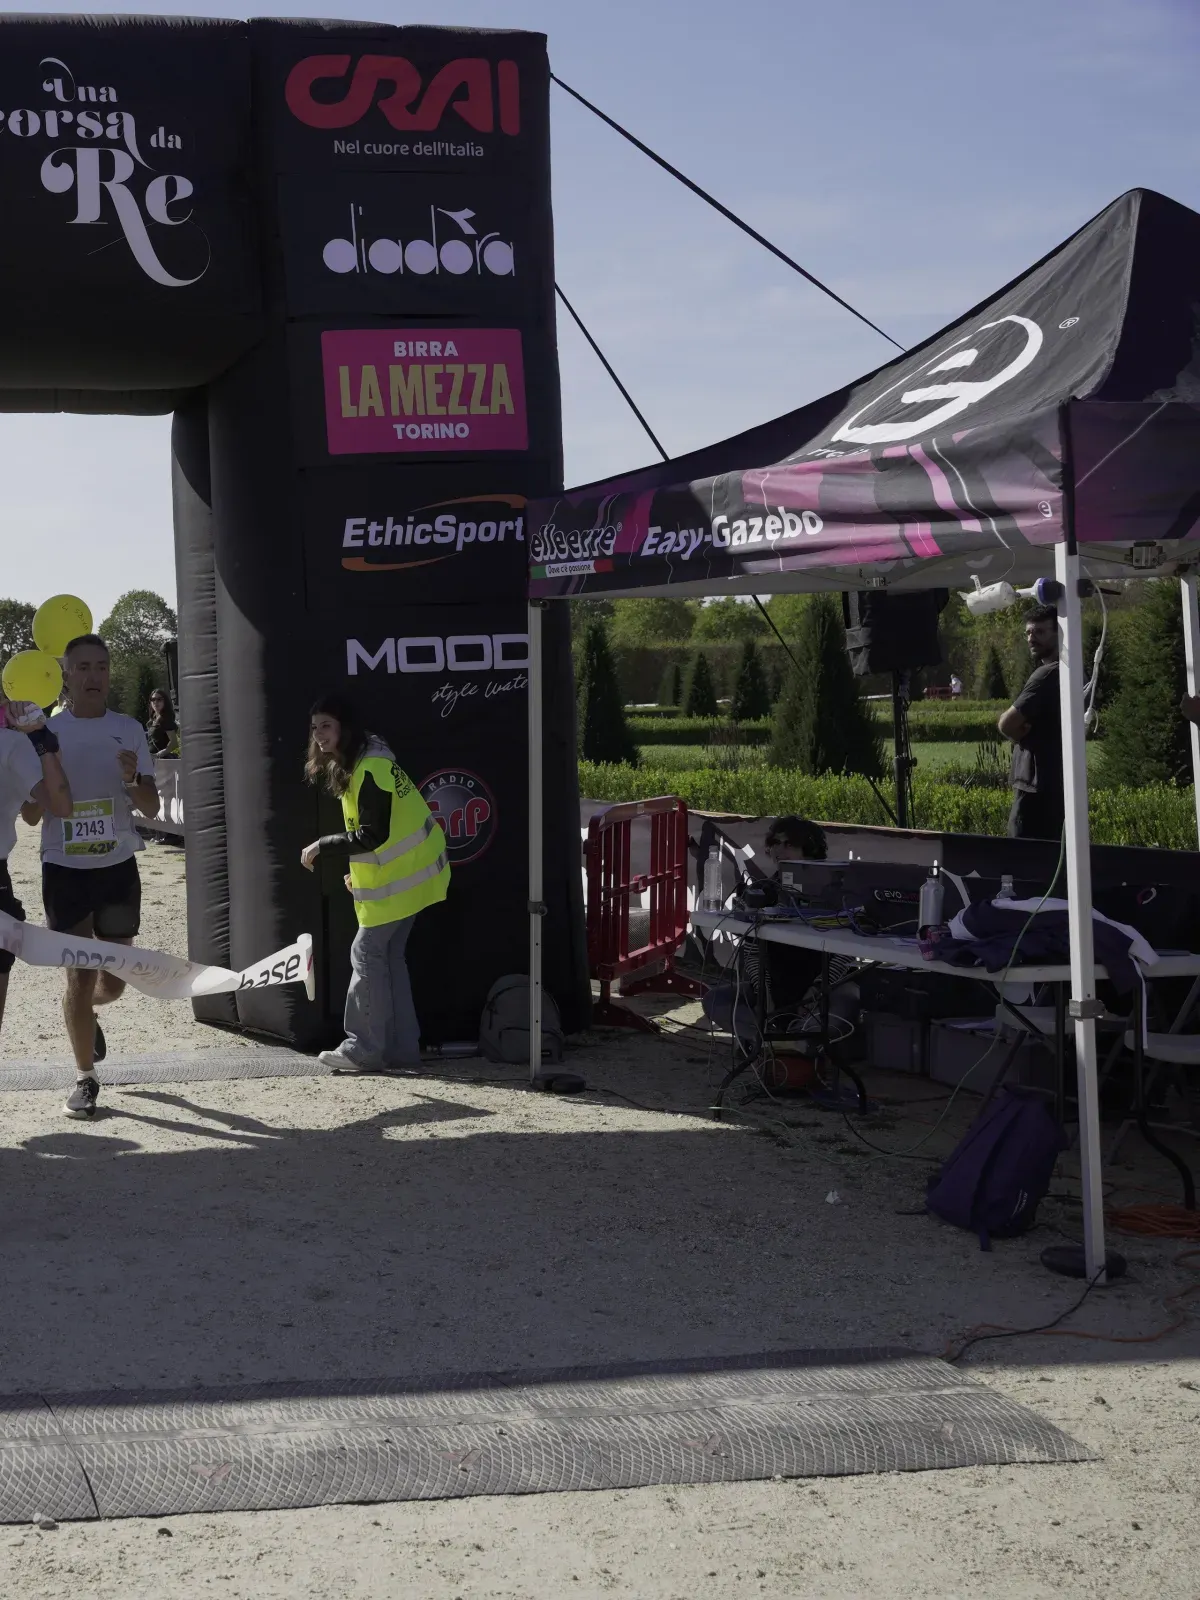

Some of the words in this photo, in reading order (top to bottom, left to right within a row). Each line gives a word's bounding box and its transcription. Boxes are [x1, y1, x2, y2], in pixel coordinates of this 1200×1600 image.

[39, 57, 118, 103] Una
[284, 53, 521, 137] CRAI
[149, 125, 183, 150] da
[333, 139, 360, 154] Nel
[363, 141, 410, 156] cuore
[412, 141, 485, 158] dell'Italia
[40, 146, 211, 287] Re
[322, 202, 516, 277] diadora
[393, 340, 459, 358] BIRRA
[338, 364, 386, 419] LA
[388, 363, 516, 417] MEZZA
[392, 422, 471, 440] TORINO
[342, 514, 525, 552] EthicSport
[640, 505, 824, 561] Easy-Gazebo
[346, 633, 528, 676] MOOD
[431, 682, 480, 718] style
[484, 673, 529, 698] wate
[427, 775, 475, 792] RADIO
[75, 819, 105, 837] 2143
